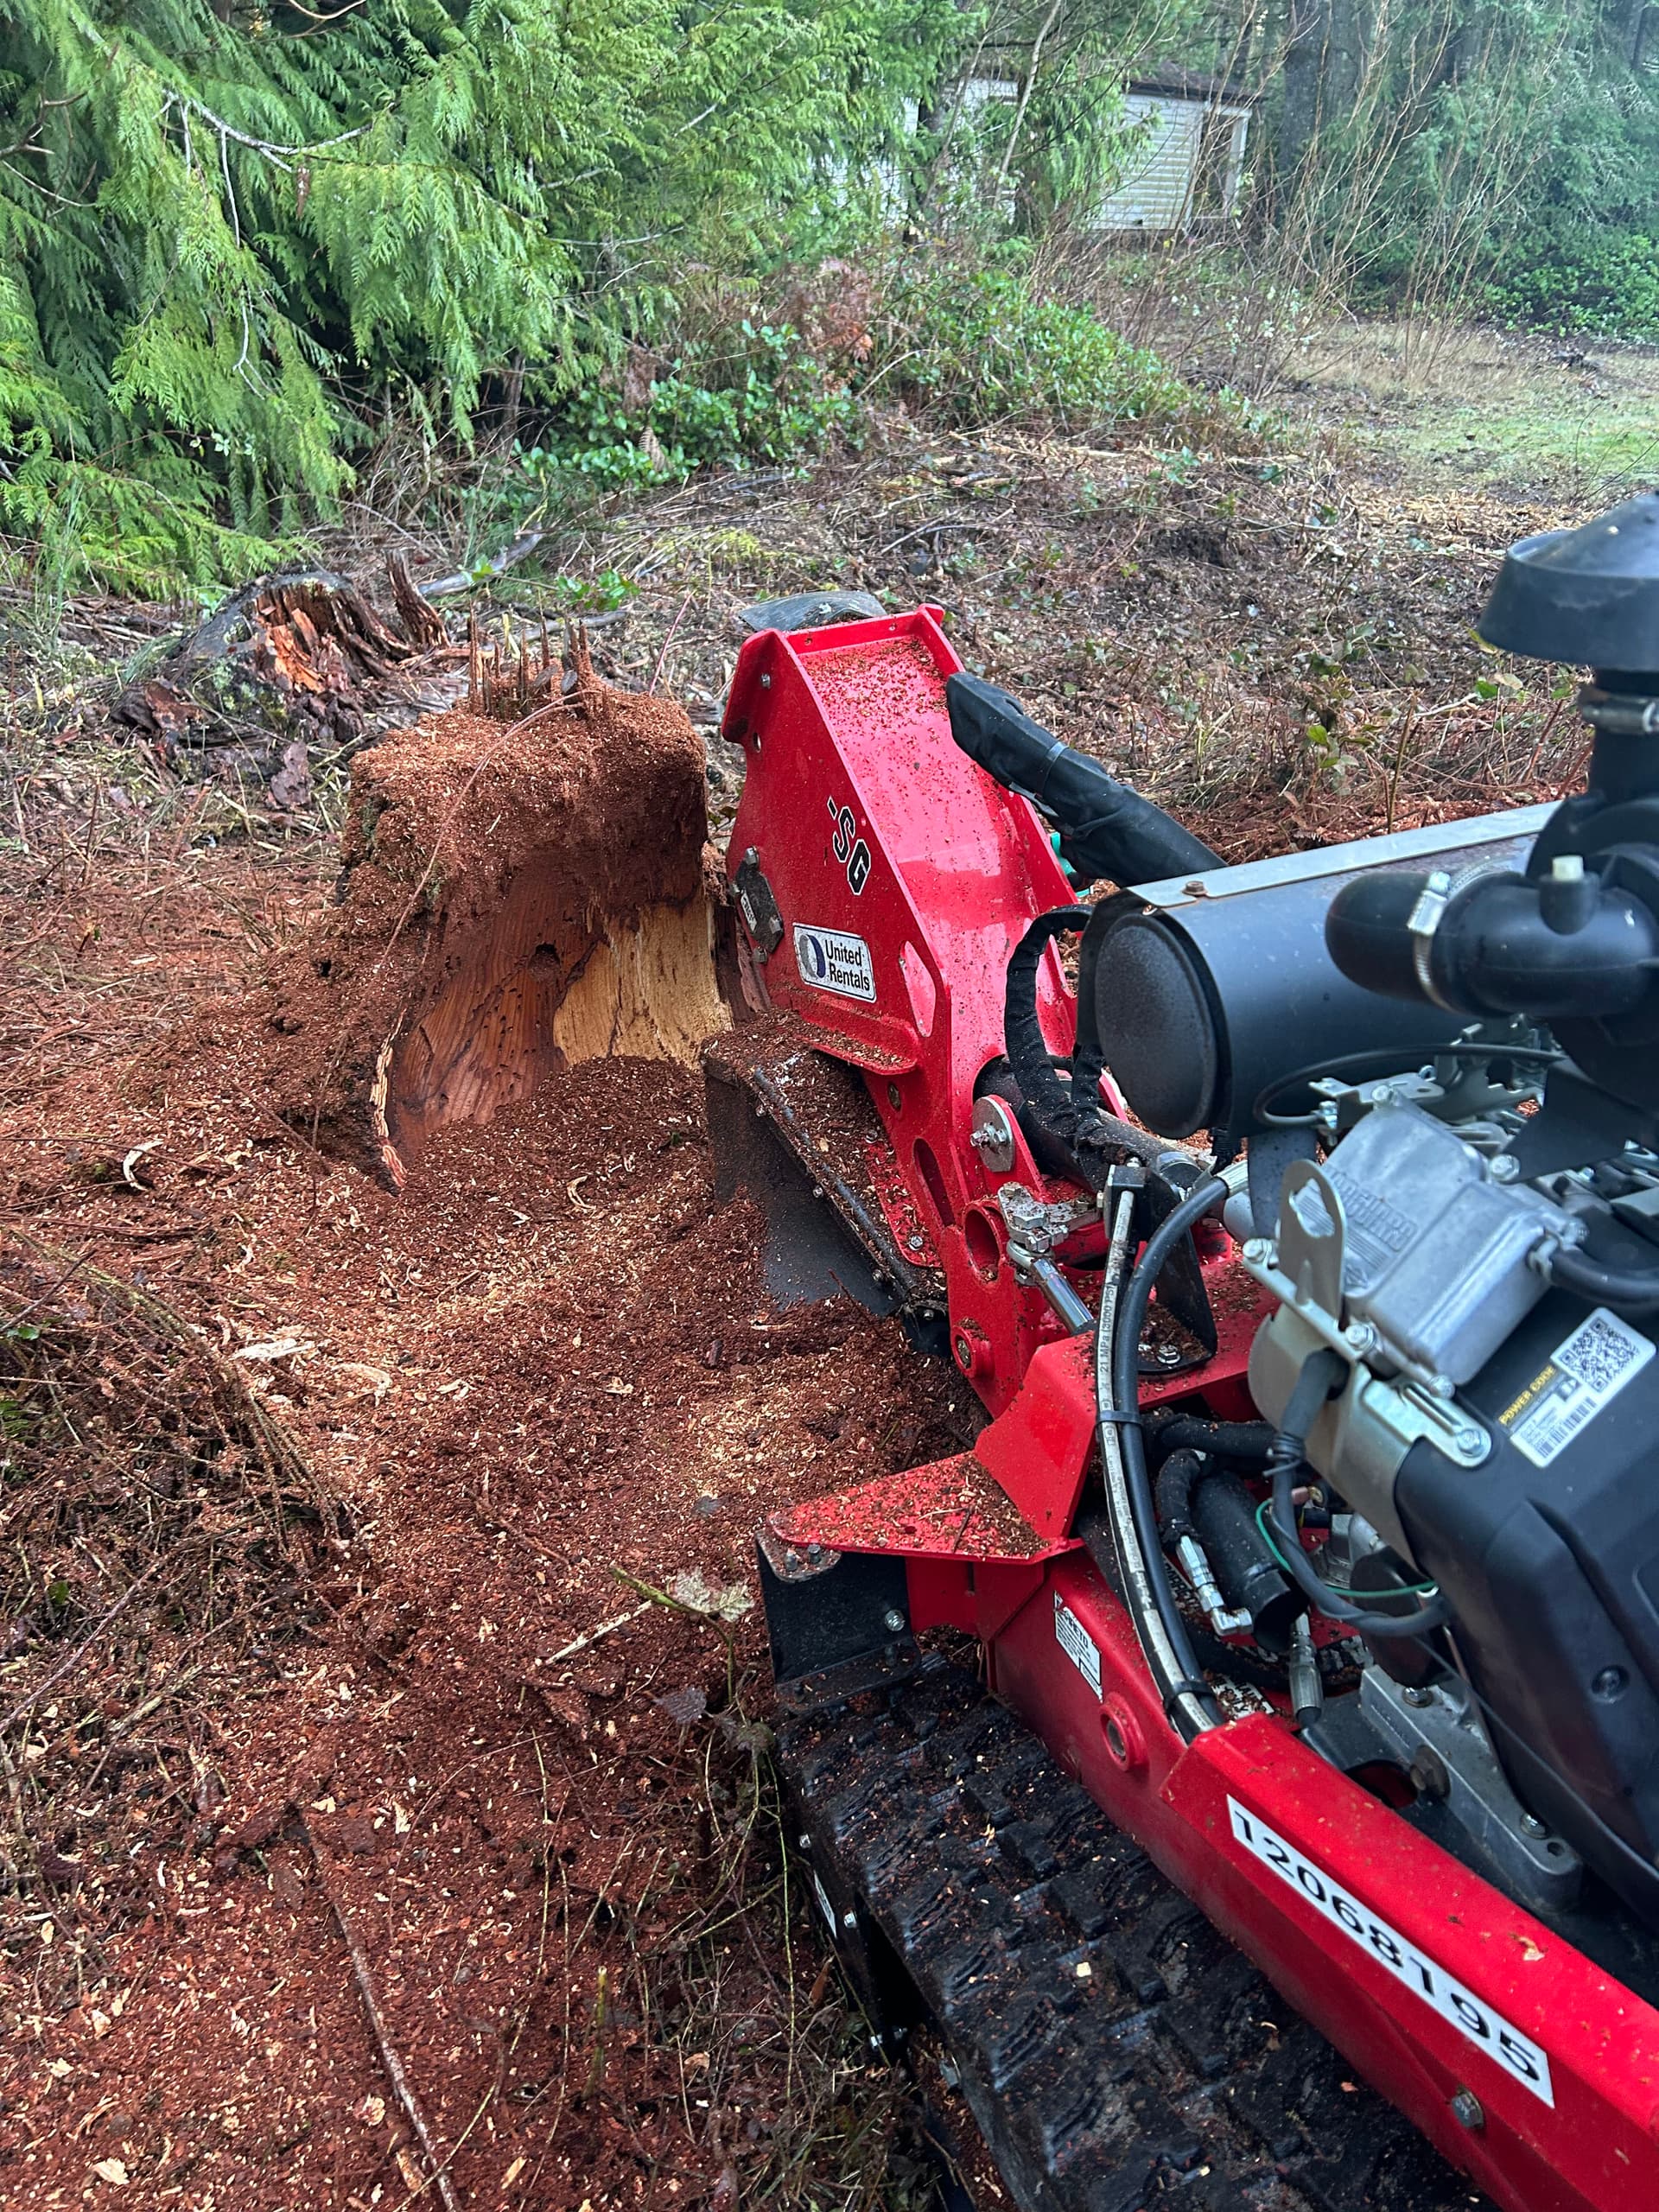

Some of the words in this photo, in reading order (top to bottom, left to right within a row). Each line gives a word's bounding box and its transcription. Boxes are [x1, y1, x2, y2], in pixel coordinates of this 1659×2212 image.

[824, 939, 862, 967] United
[829, 963, 870, 992] Rentals
[1099, 1335, 1110, 1358] MPa
[1100, 1361, 1110, 1372] 21
[1498, 1389, 1534, 1425] POWER
[1529, 1364, 1556, 1392] CODE
[1234, 1809, 1541, 2082] 12068195
